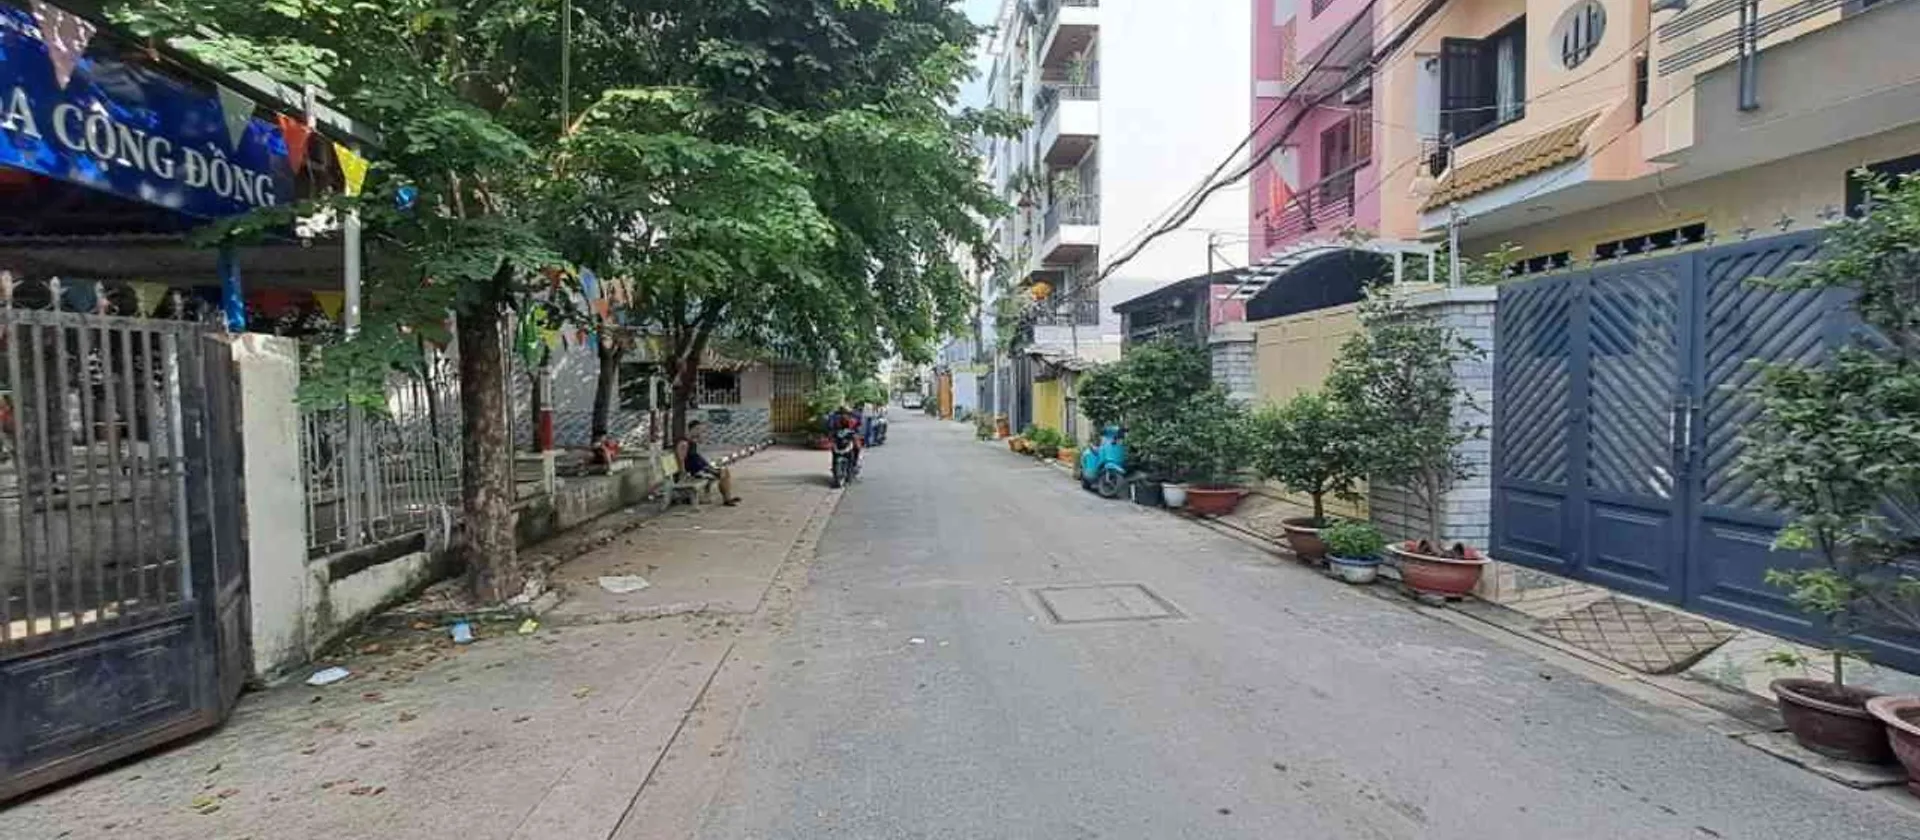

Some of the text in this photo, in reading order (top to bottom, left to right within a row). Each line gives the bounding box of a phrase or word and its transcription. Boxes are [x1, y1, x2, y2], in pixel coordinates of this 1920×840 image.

[0, 87, 275, 207] A CỘNG ĐỒNG
